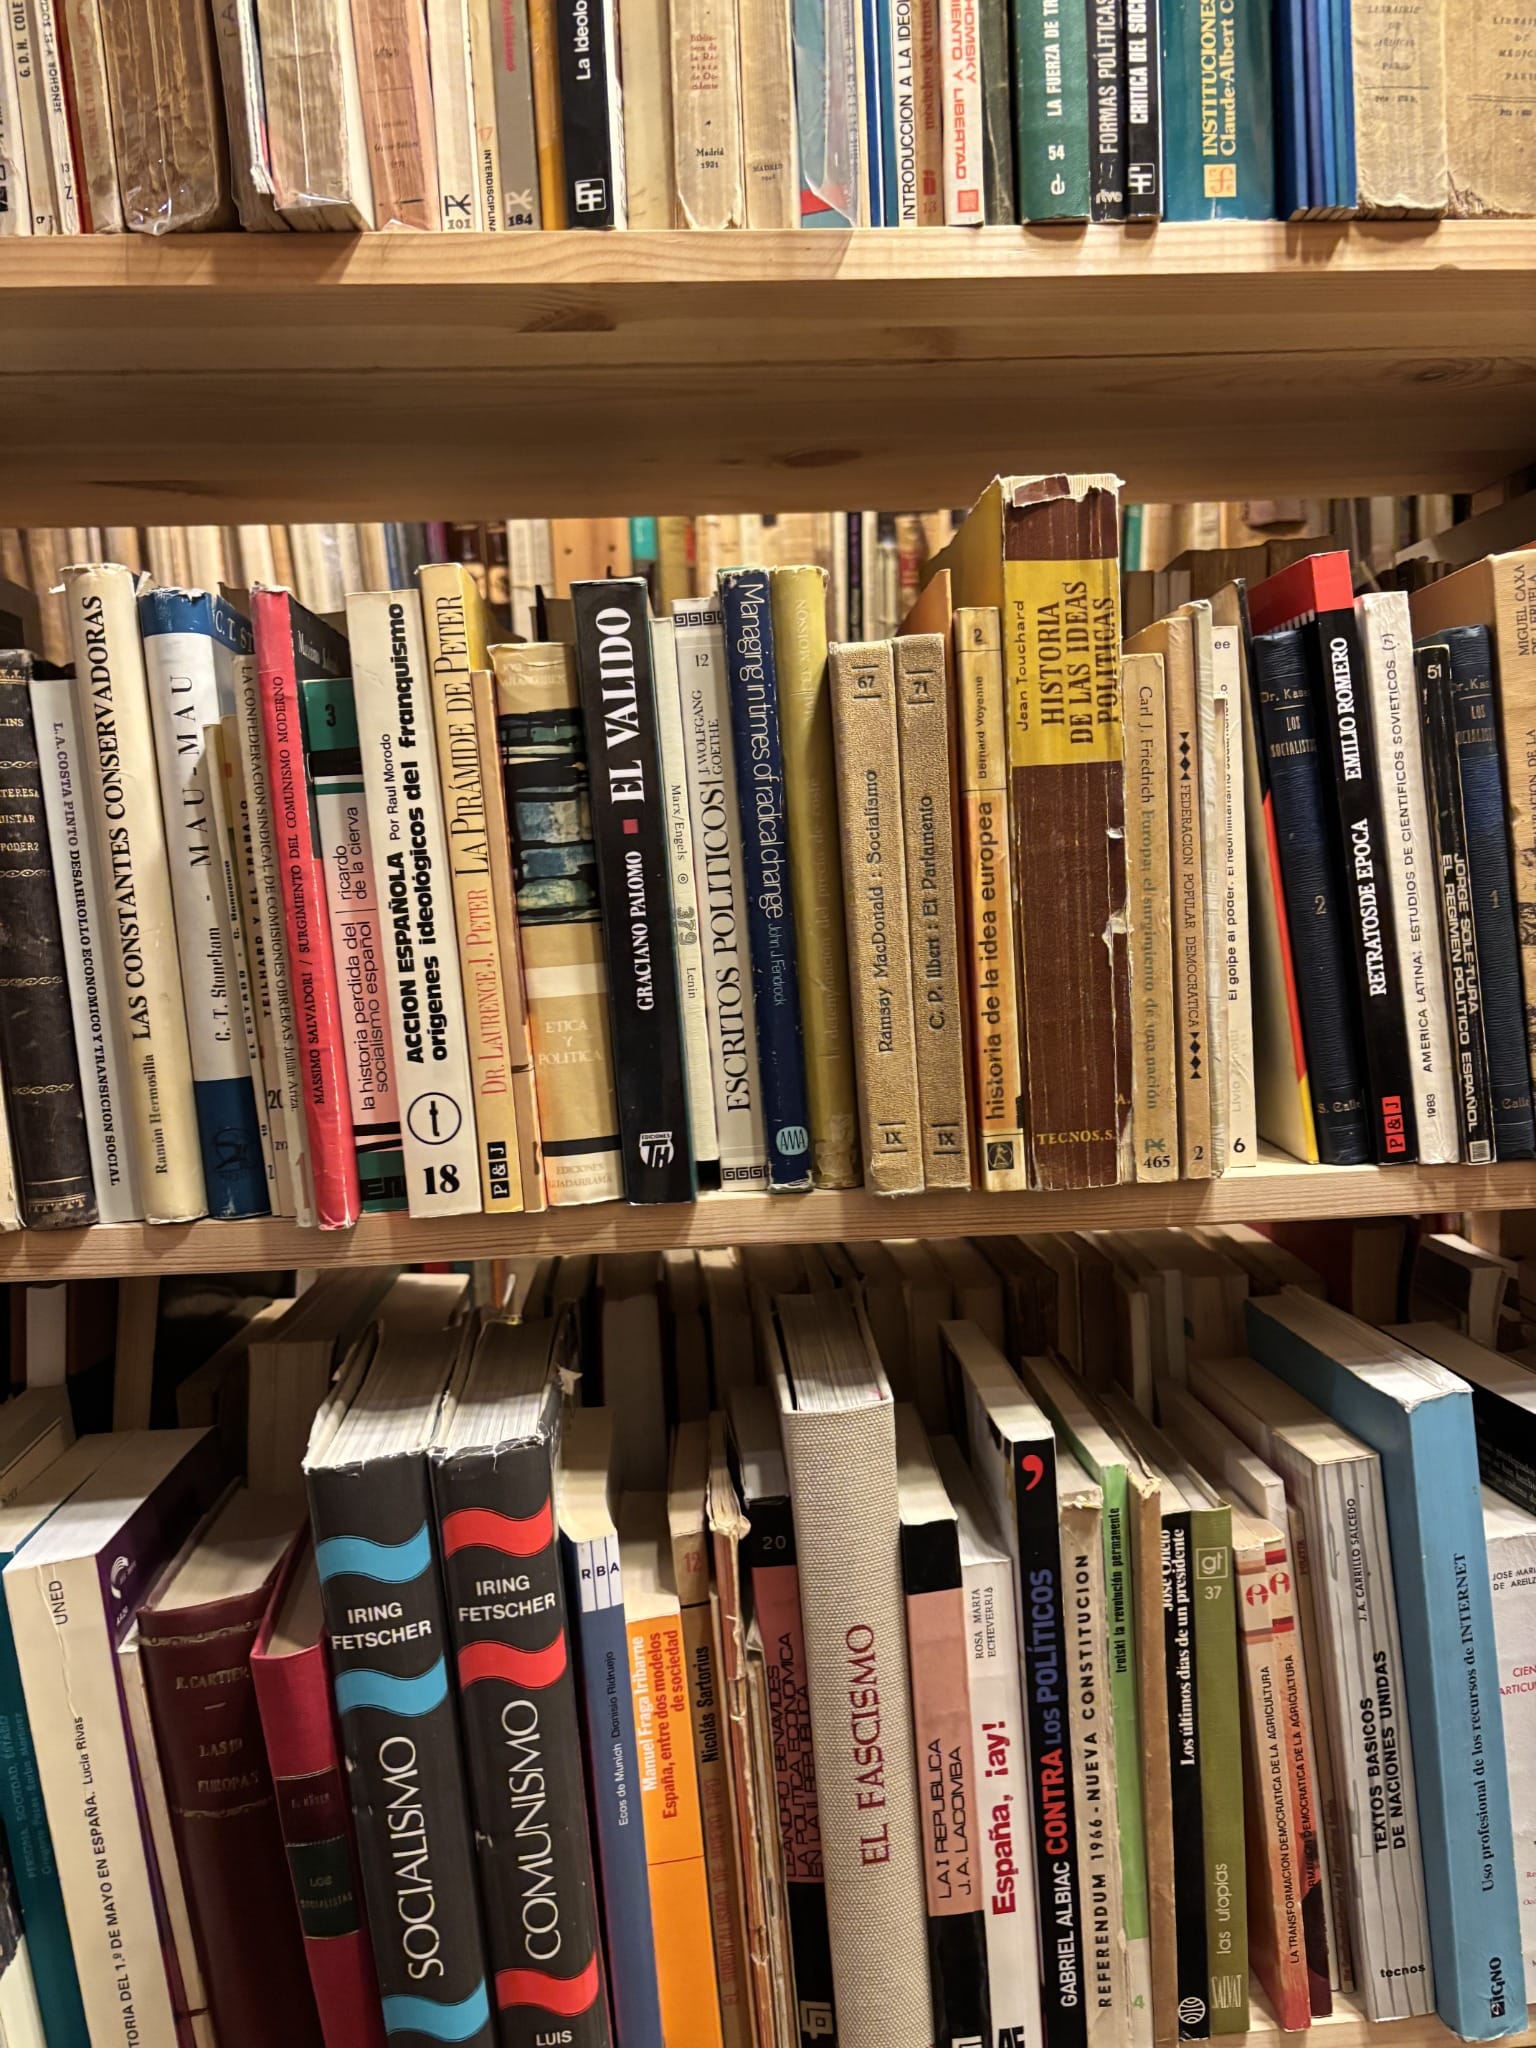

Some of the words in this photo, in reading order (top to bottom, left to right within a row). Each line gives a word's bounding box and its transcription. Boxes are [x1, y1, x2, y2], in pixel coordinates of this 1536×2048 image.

[1043, 20, 1059, 38] DE
[1128, 38, 1147, 63] DEL
[47, 61, 62, 113] SENGHOR
[576, 58, 591, 80] La
[898, 47, 911, 70] LA
[899, 75, 912, 87] A
[953, 70, 964, 81] Y
[1044, 44, 1062, 94] FUERZA
[1047, 99, 1062, 117] LA
[1130, 67, 1148, 124] CRITICA
[695, 148, 724, 157] Madrid
[900, 94, 916, 220] INTRODUCCION
[953, 88, 967, 180] LIBERTAD
[1048, 145, 1065, 161] 54
[434, 594, 468, 677] PETER
[737, 583, 765, 681] Managing
[1013, 600, 1028, 686] Touchard
[1063, 581, 1089, 653] IDEAS
[1382, 633, 1395, 652] (7)
[387, 602, 417, 749] franquismo
[595, 607, 641, 749] VALIDO
[695, 653, 710, 667] 12
[858, 676, 876, 689] 67
[1037, 602, 1065, 725] HISTORIA
[1067, 664, 1092, 709] LAS
[1092, 597, 1121, 724] POLITICAS
[1330, 637, 1354, 714] ROMERO
[82, 596, 125, 820] CONSERVADORAS
[444, 682, 472, 715] DE
[749, 684, 765, 701] in
[1016, 690, 1028, 732] Jean
[1386, 659, 1403, 745] SOVIETICOS
[708, 718, 723, 775] GOETHE
[750, 703, 772, 759] times
[1070, 713, 1093, 744] DE
[1338, 718, 1362, 782] EMILIO
[380, 734, 396, 782] Morodo
[400, 761, 420, 802] del
[448, 722, 486, 838] PIRÁMIDE
[609, 760, 645, 804] EL
[754, 761, 779, 784] of
[385, 784, 399, 814] Raul
[671, 784, 688, 860] Marx/Engels
[757, 784, 783, 846] radical
[865, 770, 882, 865] Socialismo
[1180, 785, 1194, 865] FEDERACION
[1395, 752, 1412, 843] CIENTIFICOS
[390, 816, 401, 840] Por
[978, 801, 1000, 901] europea
[1404, 847, 1413, 866] DE
[333, 845, 351, 900] ricardo
[408, 806, 436, 946] ideológicos
[454, 843, 489, 878] LA
[625, 851, 648, 918] PALOMO
[700, 790, 738, 955] POLITICOS
[758, 848, 786, 919] change
[1442, 854, 1453, 877] EL
[109, 828, 144, 988] CONSTANTES
[387, 851, 416, 974] ESPAÑOLA
[1183, 873, 1196, 930] POPULAR
[1408, 880, 1422, 942] ESTUDIOS
[1445, 884, 1462, 963] REGIMEN
[341, 922, 358, 951] del
[359, 921, 379, 998] español
[867, 886, 888, 978] MacDonald
[978, 912, 998, 961] idea
[346, 955, 365, 1029] perdida
[631, 922, 656, 1012] GRACIANO
[686, 967, 696, 999] Lenin
[979, 967, 999, 991] la
[1185, 936, 1200, 1027] DEMOCRATICA
[1415, 951, 1427, 1002] LATINA:
[132, 995, 151, 1042] LAS
[399, 981, 425, 1063] ACCION
[879, 988, 894, 1053] Ramsay
[981, 995, 1000, 1025] de
[1453, 965, 1470, 1045] POLITICO
[354, 1031, 373, 1095] historia
[368, 1000, 388, 1094] socialismo
[715, 966, 750, 1113] ESCRITOS
[1418, 1011, 1432, 1072] AMERICA
[143, 1054, 163, 1124] Hermosilla
[361, 1096, 376, 1111] la
[985, 1035, 1004, 1119] historia
[1462, 1052, 1478, 1133] ESPAÑOL
[155, 1127, 168, 1175] Ramón
[1144, 1155, 1170, 1168] 465
[1233, 1138, 1246, 1153] 6
[423, 1164, 461, 1195] 18
[763, 1535, 787, 1550] 20
[1110, 1507, 1124, 1567] permanente
[475, 1575, 530, 1597] IRING
[1172, 1528, 1191, 1604] presidente
[1204, 1586, 1222, 1600] 37
[49, 1580, 68, 1625] UNED
[347, 1602, 403, 1625] IRING
[458, 1592, 556, 1622] FETSCHER
[984, 1586, 996, 1657] ECHEVERRIA
[1110, 1570, 1125, 1623] revolución
[1178, 1606, 1188, 1626] un
[1453, 1553, 1474, 1646] INTERNET
[332, 1620, 432, 1650] FETSCHER
[1025, 1568, 1060, 1704] POLÍTICOS
[1075, 1554, 1095, 1721] CONSTITUCION
[1113, 1623, 1125, 1637] la
[1114, 1638, 1127, 1673] trotski
[1174, 1625, 1190, 1643] de
[1464, 1648, 1476, 1665] de
[630, 1636, 650, 1697] Iribarne
[651, 1632, 668, 1693] modelos
[1173, 1644, 1192, 1676] días
[1374, 1651, 1394, 1718] UNIDAS
[635, 1697, 655, 1737] Fraga
[656, 1696, 668, 1721] dos
[846, 1624, 886, 1810] FASCISMO
[1045, 1707, 1062, 1745] LOS
[1175, 1676, 1193, 1736] últimos
[1464, 1669, 1482, 1736] recursos
[638, 1736, 657, 1793] Manuel
[658, 1721, 674, 1759] entre
[1180, 1739, 1195, 1767] Los
[1360, 1698, 1380, 1776] BASICOS
[1472, 1739, 1484, 1757] los
[662, 1760, 677, 1820] España,
[1084, 1732, 1100, 1800] NUEVA
[1384, 1727, 1404, 1818] NACIONES
[1473, 1758, 1486, 1776] de
[949, 1746, 968, 1853] LACOMBA
[1041, 1748, 1069, 1856] CONTRA
[1369, 1784, 1388, 1854] TEXTOS
[1474, 1777, 1494, 1860] profesional
[379, 1736, 444, 1979] SOCIALISMO
[501, 1700, 561, 1960] COMUNISMO
[860, 1823, 890, 1867] EL
[1088, 1819, 1104, 1861] 1966
[1393, 1829, 1407, 1850] DE
[956, 1857, 970, 1878] A.
[958, 1880, 971, 1896] J.
[1053, 1860, 1074, 1927] ALBIAC
[1482, 1864, 1495, 1892] Uso
[1091, 1873, 1112, 2008] REFERENDUM
[1058, 1931, 1078, 2008] GABRIEL
[1381, 1963, 1426, 1978] tecnos
